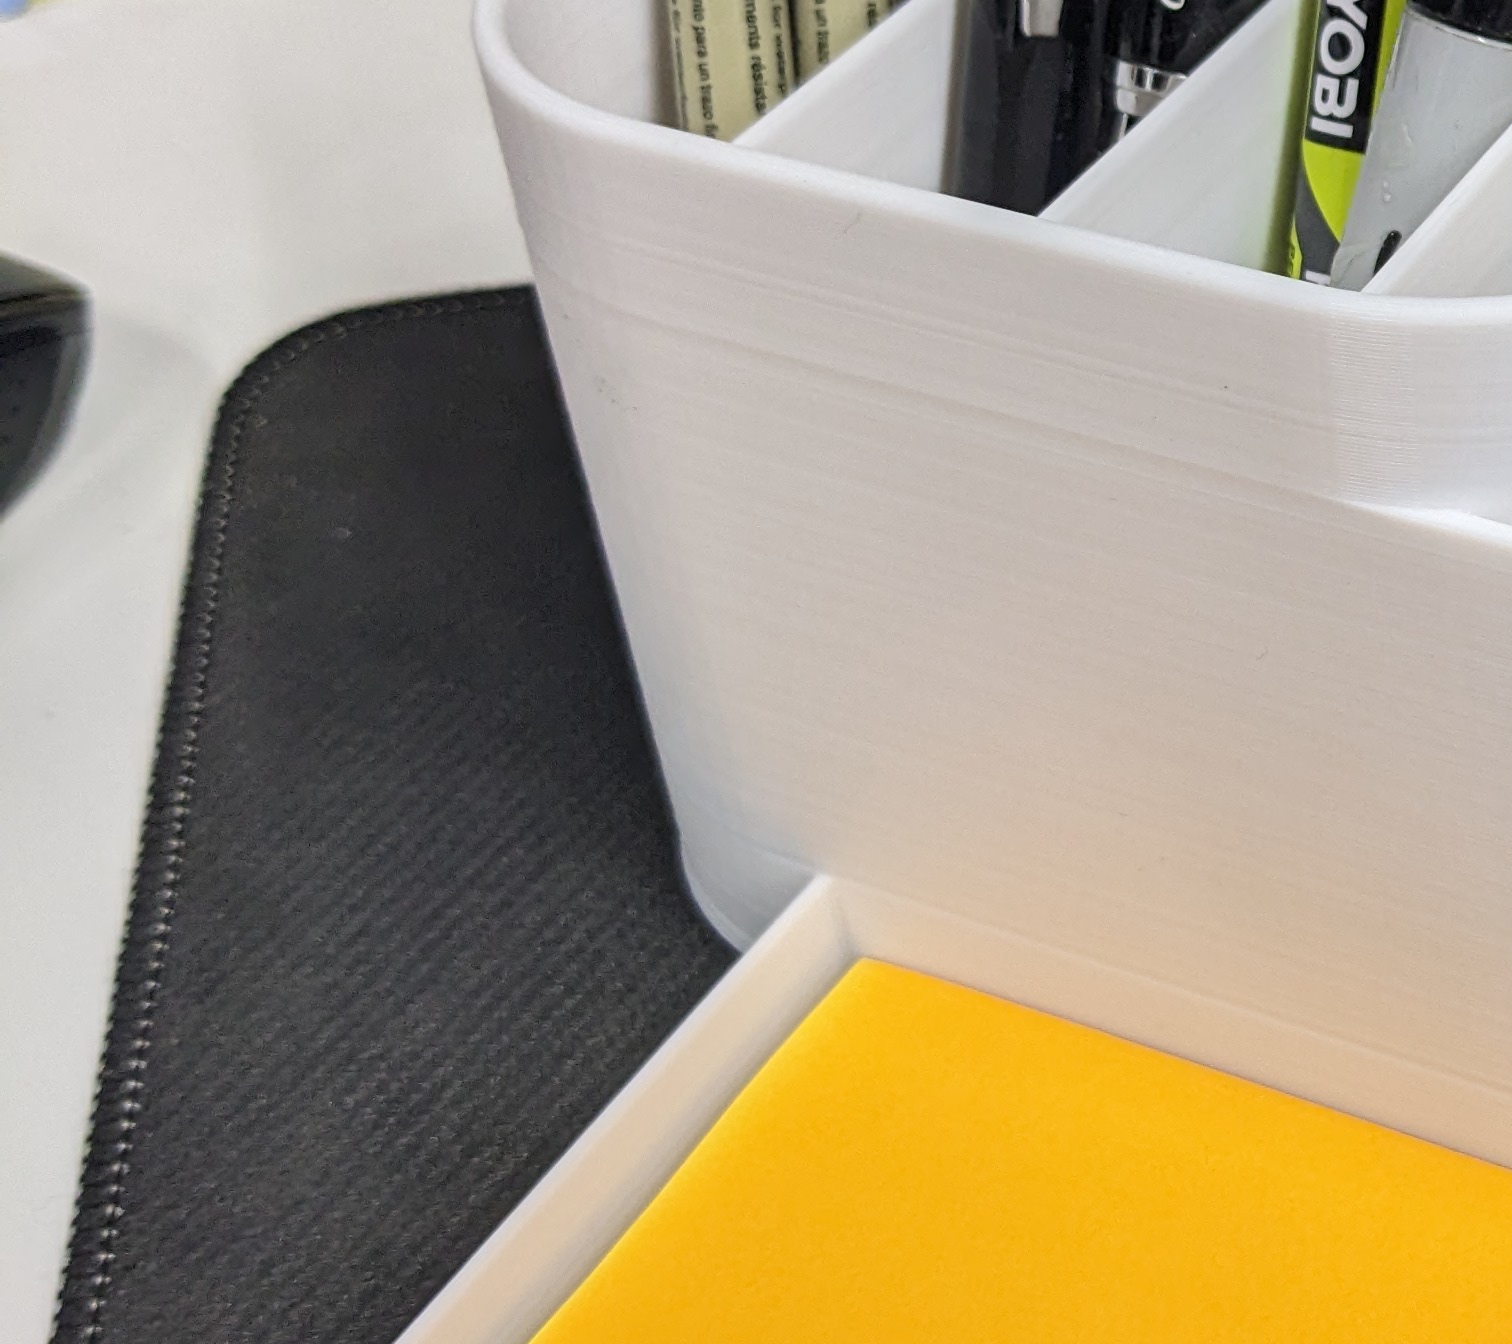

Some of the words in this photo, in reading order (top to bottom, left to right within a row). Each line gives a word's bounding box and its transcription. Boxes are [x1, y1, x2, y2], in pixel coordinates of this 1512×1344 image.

[815, 9, 828, 27] un
[692, 26, 708, 58] para
[698, 63, 710, 81] un
[700, 85, 714, 120] trazo
